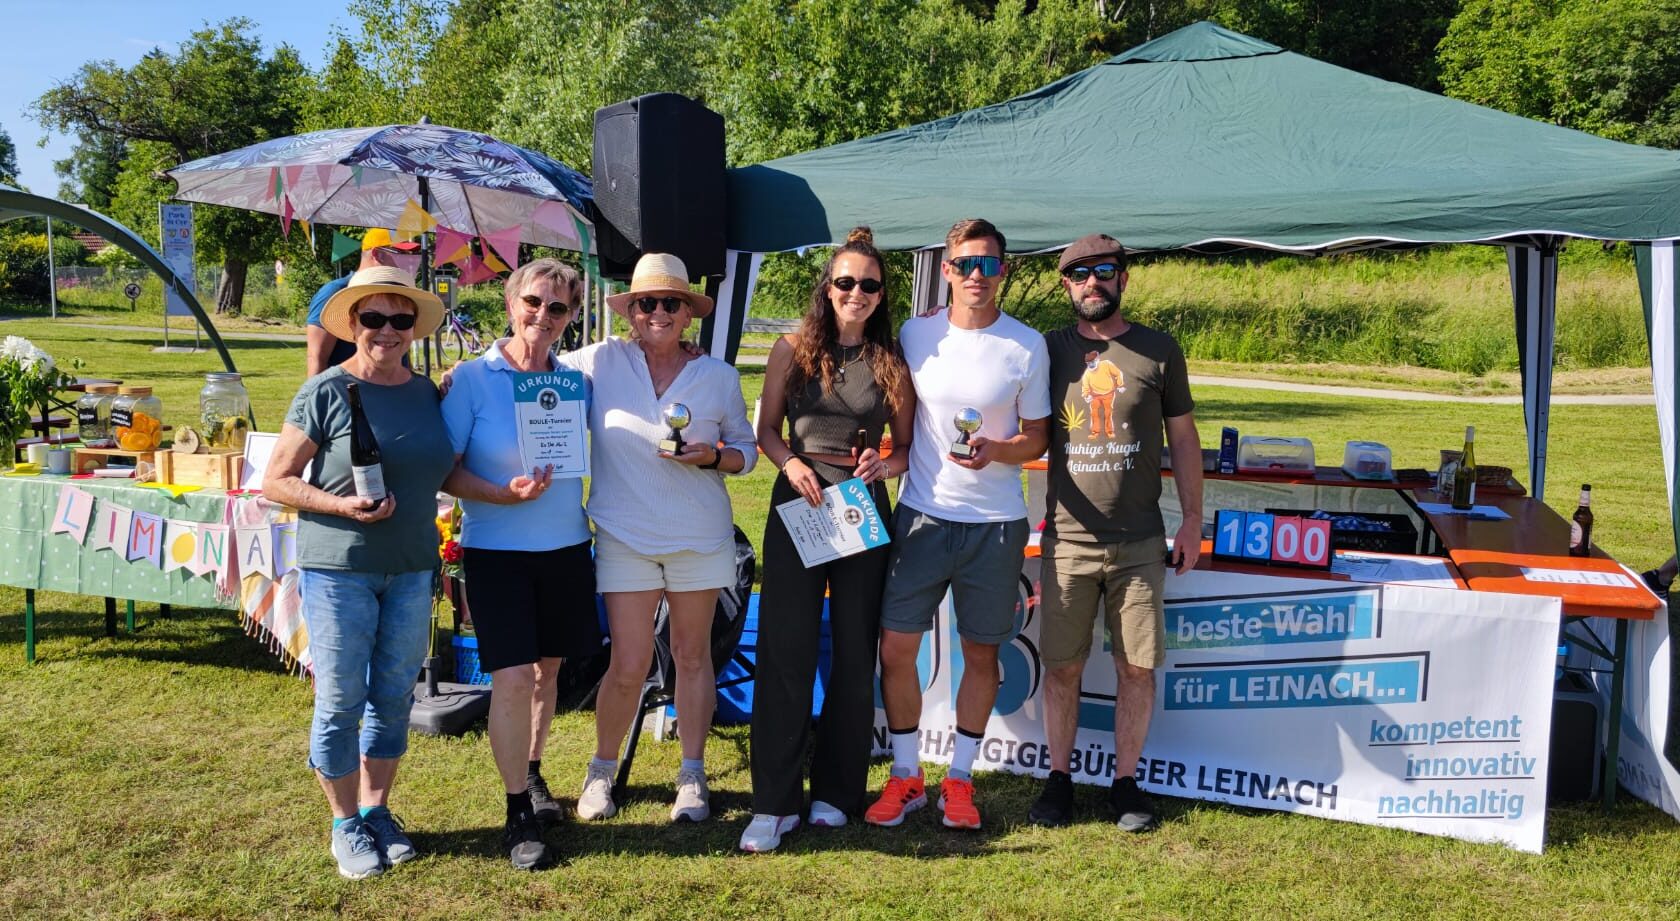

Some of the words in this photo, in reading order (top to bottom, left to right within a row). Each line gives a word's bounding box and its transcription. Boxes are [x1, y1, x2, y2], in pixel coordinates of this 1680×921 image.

[518, 375, 579, 393] URKUNDE
[1064, 441, 1104, 458] Ruhige
[1106, 441, 1141, 457] Kugel
[1068, 460, 1111, 475] Leinach
[848, 484, 879, 543] URKUNDE
[1176, 608, 1263, 642] beste
[1272, 604, 1356, 637] Wahl
[1174, 677, 1220, 704] für
[1229, 671, 1406, 702] LEINACH...
[1369, 715, 1522, 746] kompetent
[1406, 751, 1537, 777] innovativ
[1197, 765, 1338, 810] LEINACH
[1378, 788, 1525, 820] nachhaltig
